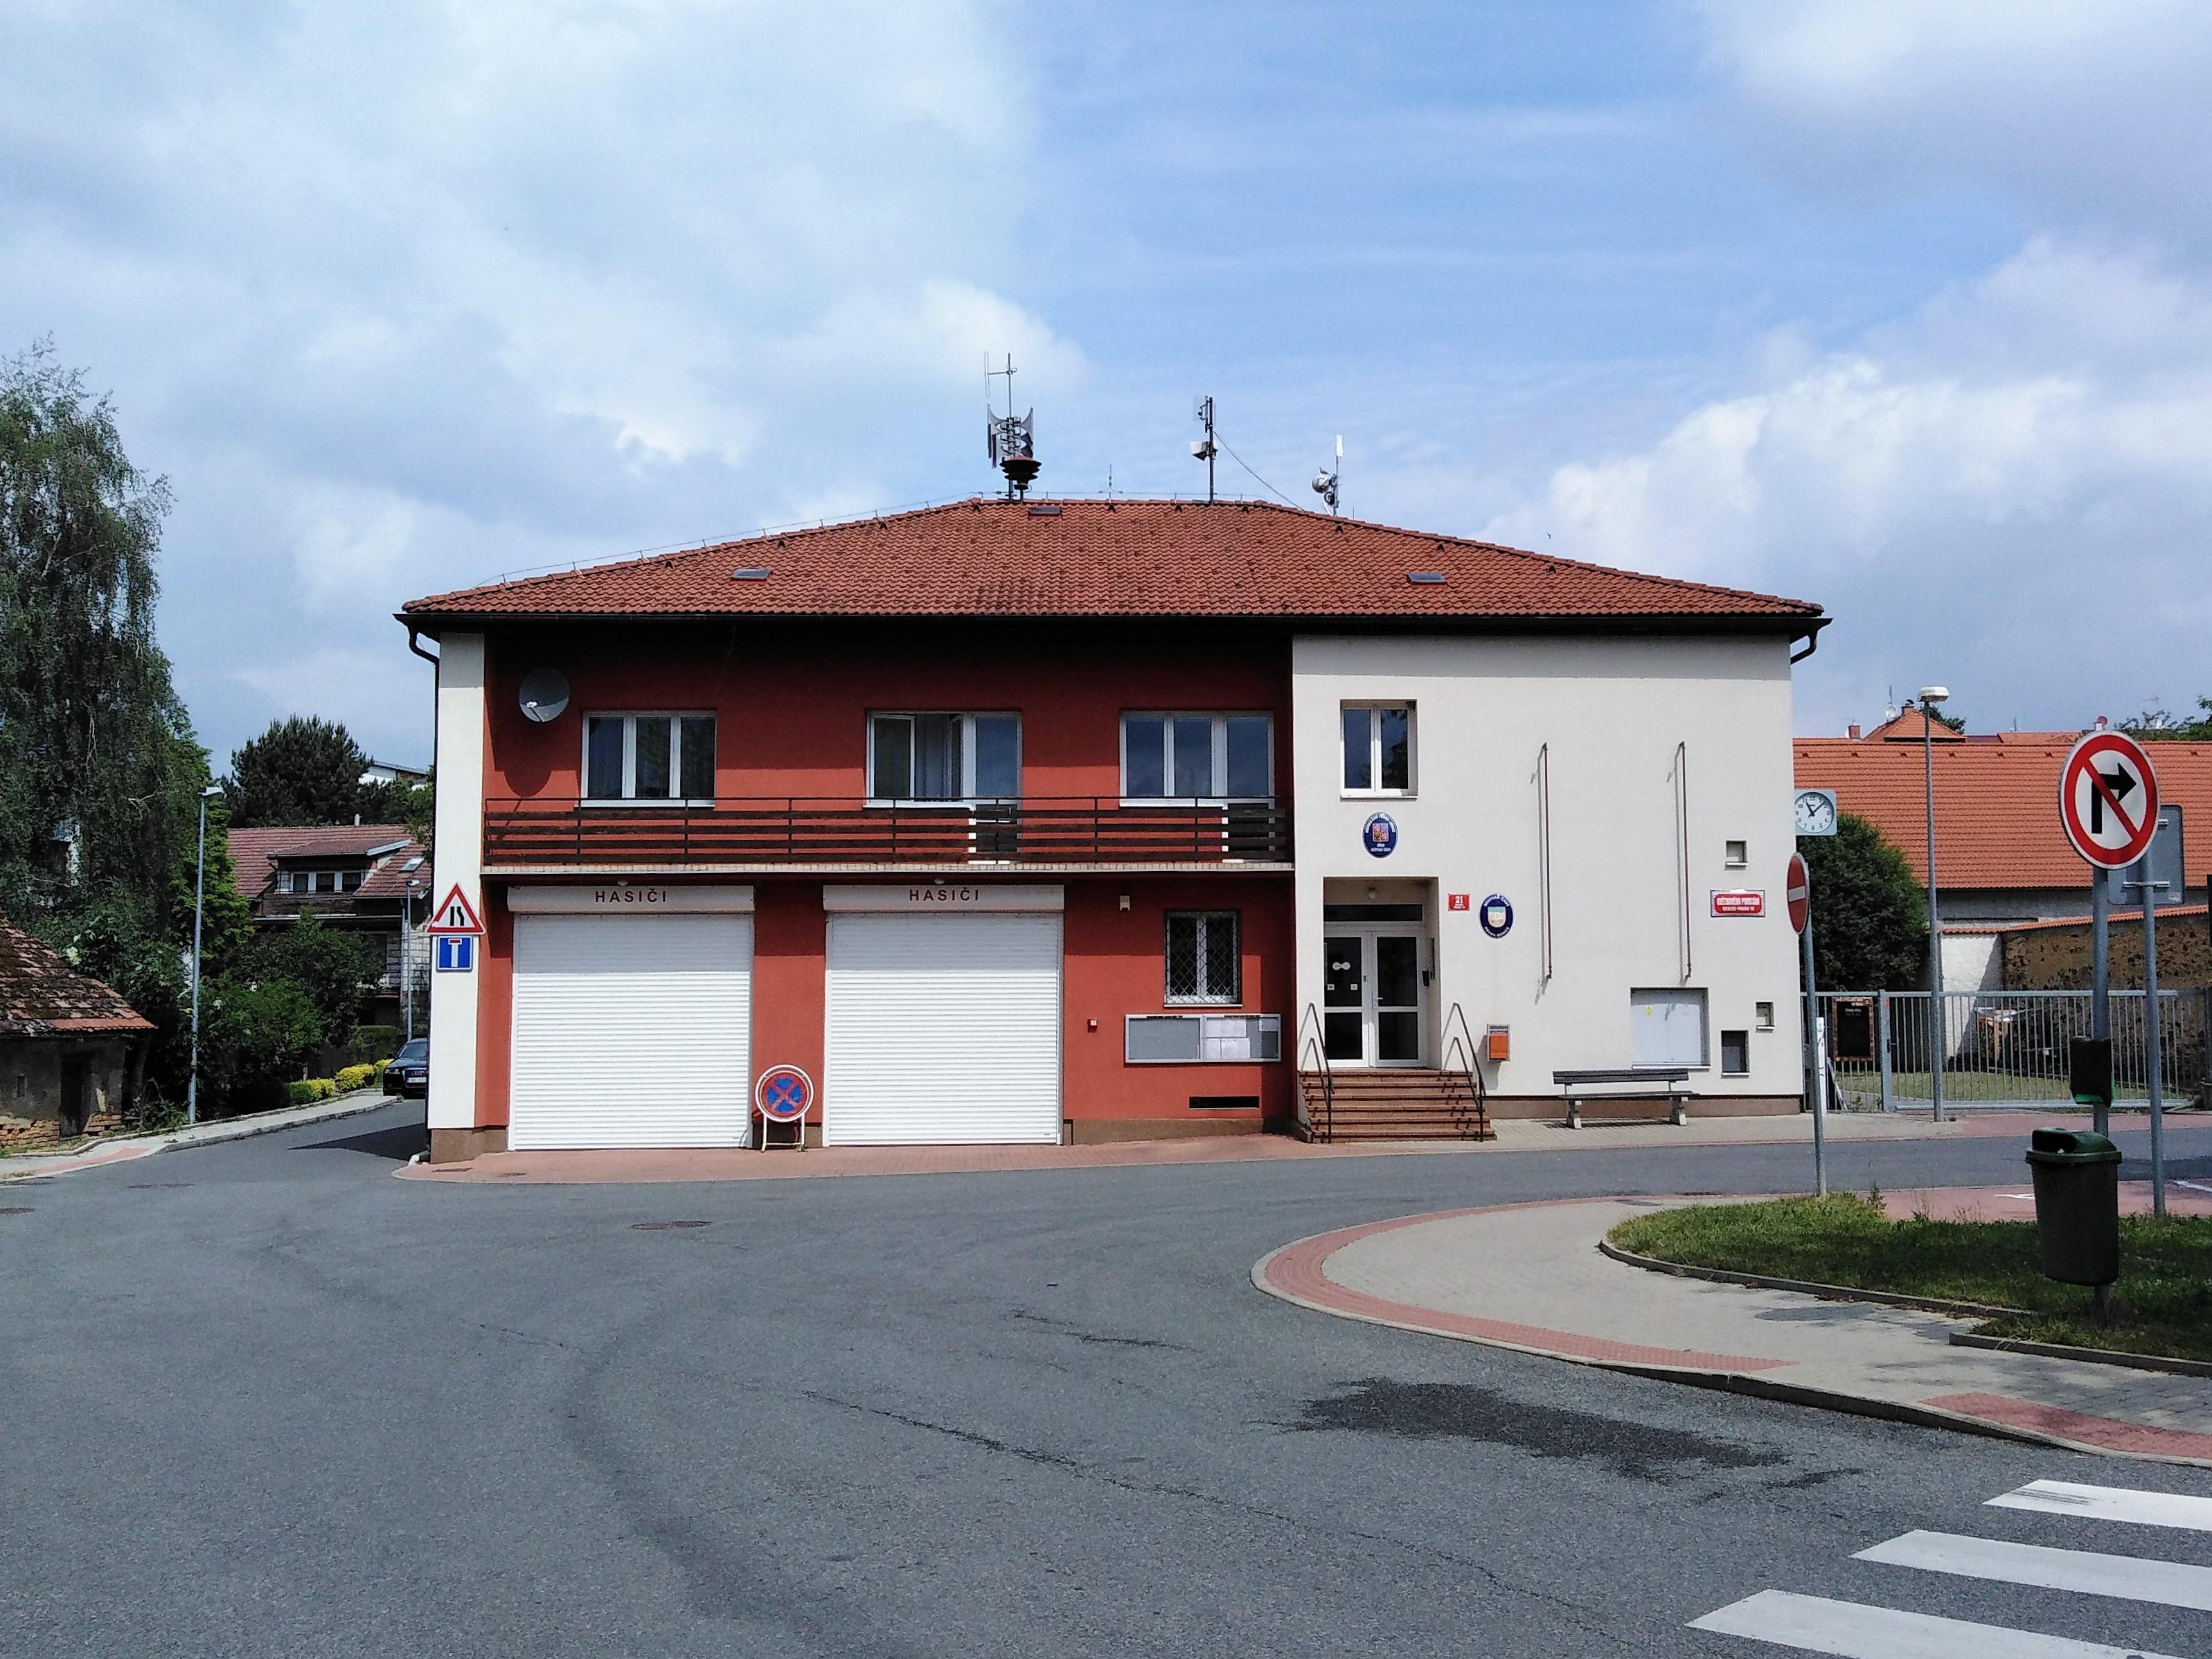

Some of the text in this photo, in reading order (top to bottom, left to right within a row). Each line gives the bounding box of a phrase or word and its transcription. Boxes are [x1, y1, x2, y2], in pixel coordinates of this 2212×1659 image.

[595, 888, 666, 903] HASIČI
[909, 887, 979, 901] HASIČI
[1455, 895, 1463, 904] 21
